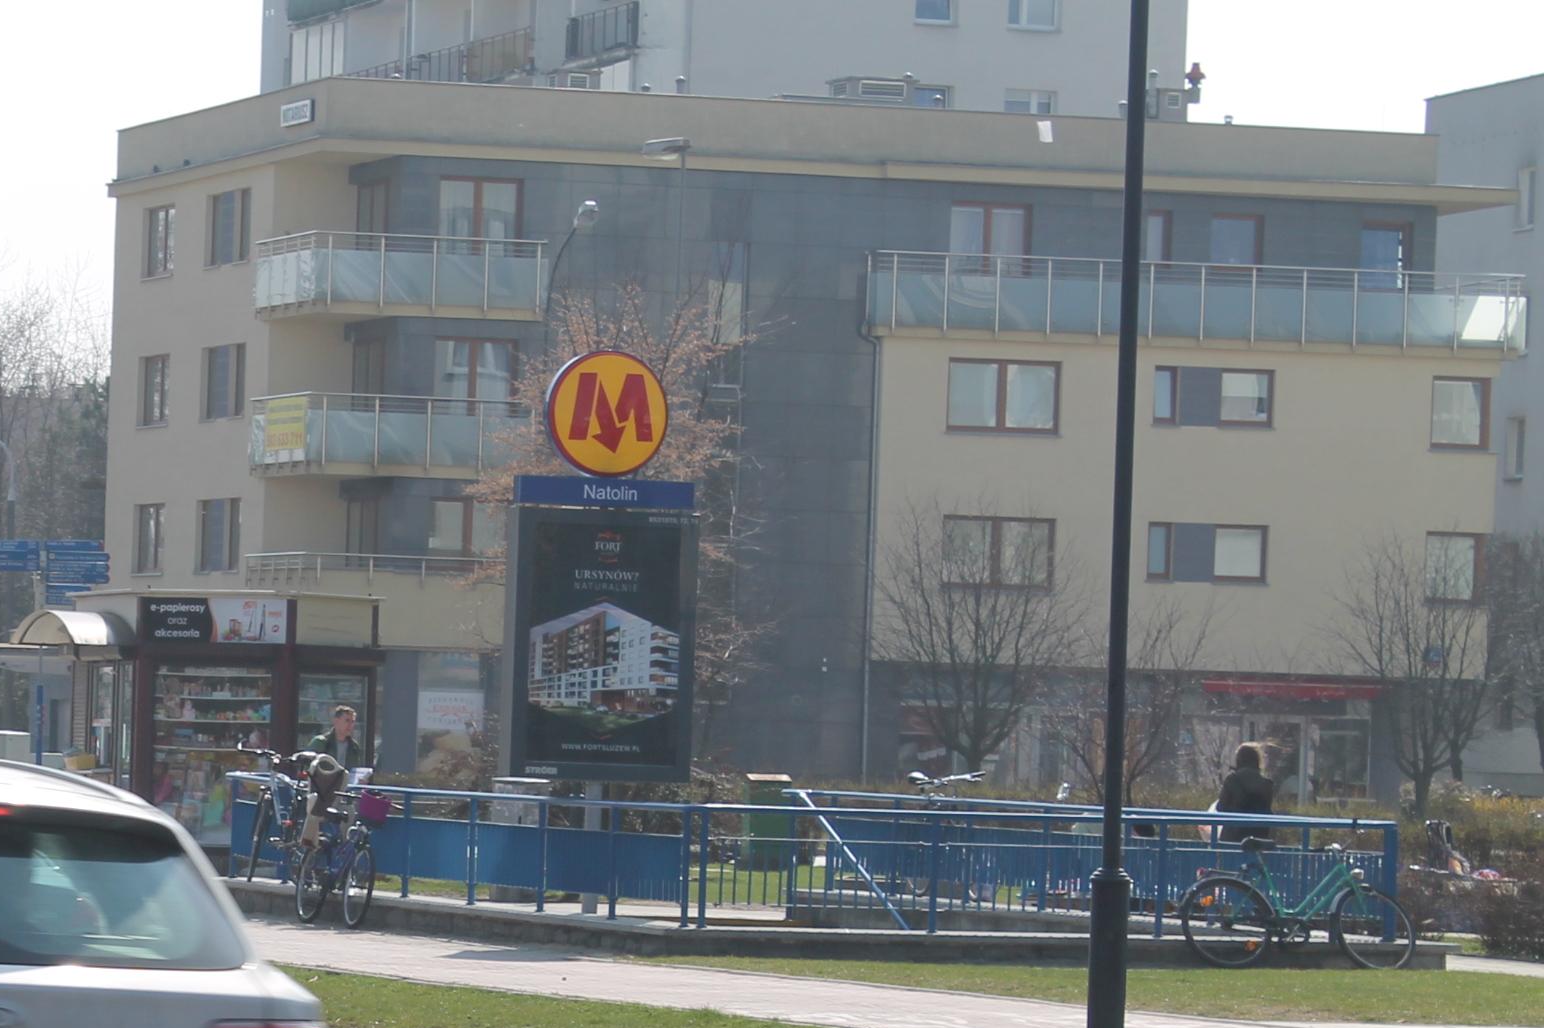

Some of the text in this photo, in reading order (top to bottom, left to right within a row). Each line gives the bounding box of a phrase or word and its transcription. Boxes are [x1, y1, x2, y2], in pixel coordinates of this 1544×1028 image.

[583, 484, 638, 501] Natolin
[594, 541, 622, 552] FORT
[574, 568, 639, 581] URSYNÓW?
[573, 581, 638, 593] NATURALNIE
[150, 602, 206, 614] e-papierosy
[167, 617, 188, 625] oraz
[154, 628, 200, 638] akcesoria
